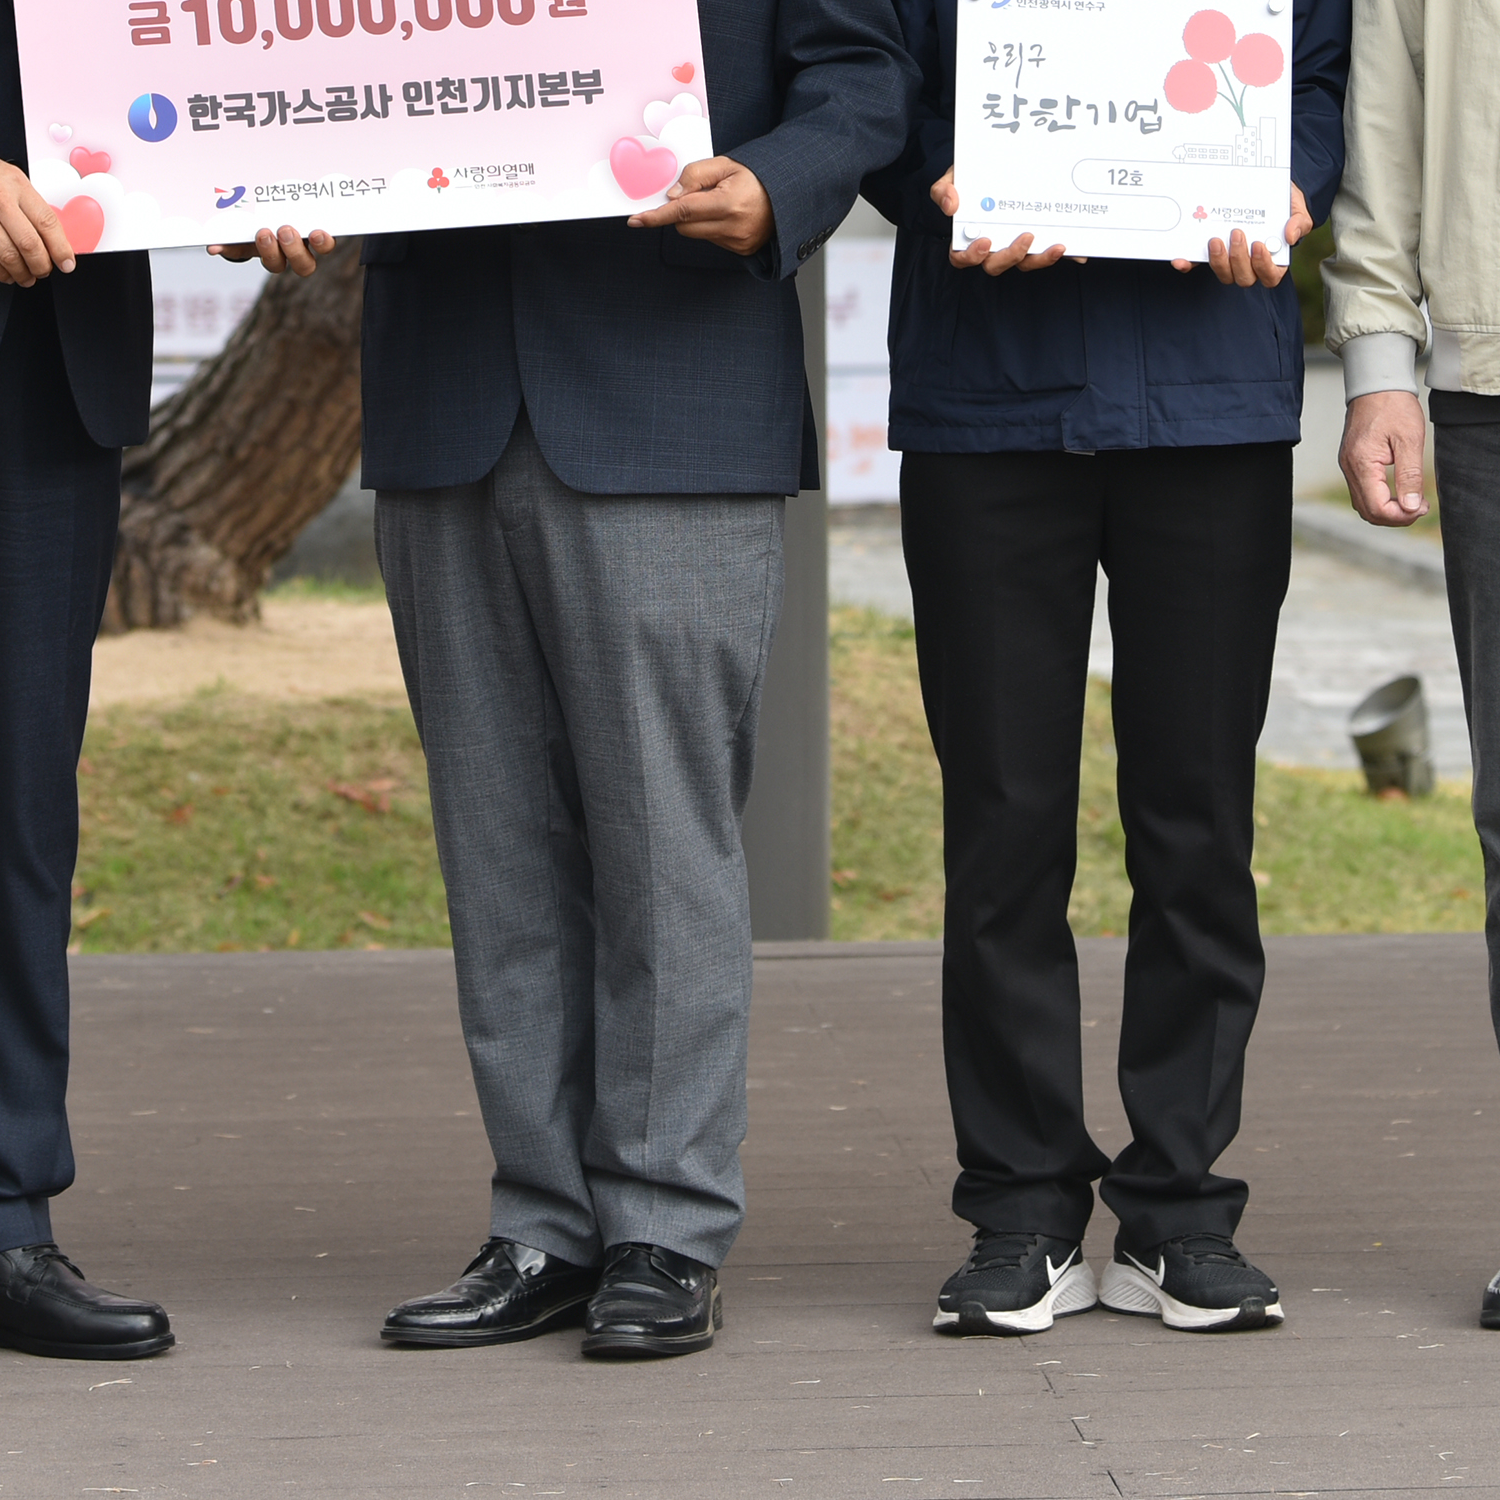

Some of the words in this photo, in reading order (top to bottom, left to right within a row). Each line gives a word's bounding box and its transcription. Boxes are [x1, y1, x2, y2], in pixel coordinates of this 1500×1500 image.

[1074, 1, 1106, 12] 연수구
[982, 41, 1047, 89] 우리구
[186, 92, 394, 133] 한국가스공사
[401, 68, 605, 118] 인천기지본부
[453, 162, 536, 183] 사랑의열매
[1107, 168, 1144, 187] 12호
[254, 180, 335, 203] 인천광역시
[338, 177, 387, 197] 연수구
[998, 200, 1052, 213] 한국가스공사
[1054, 202, 1109, 215] 인천기지본부
